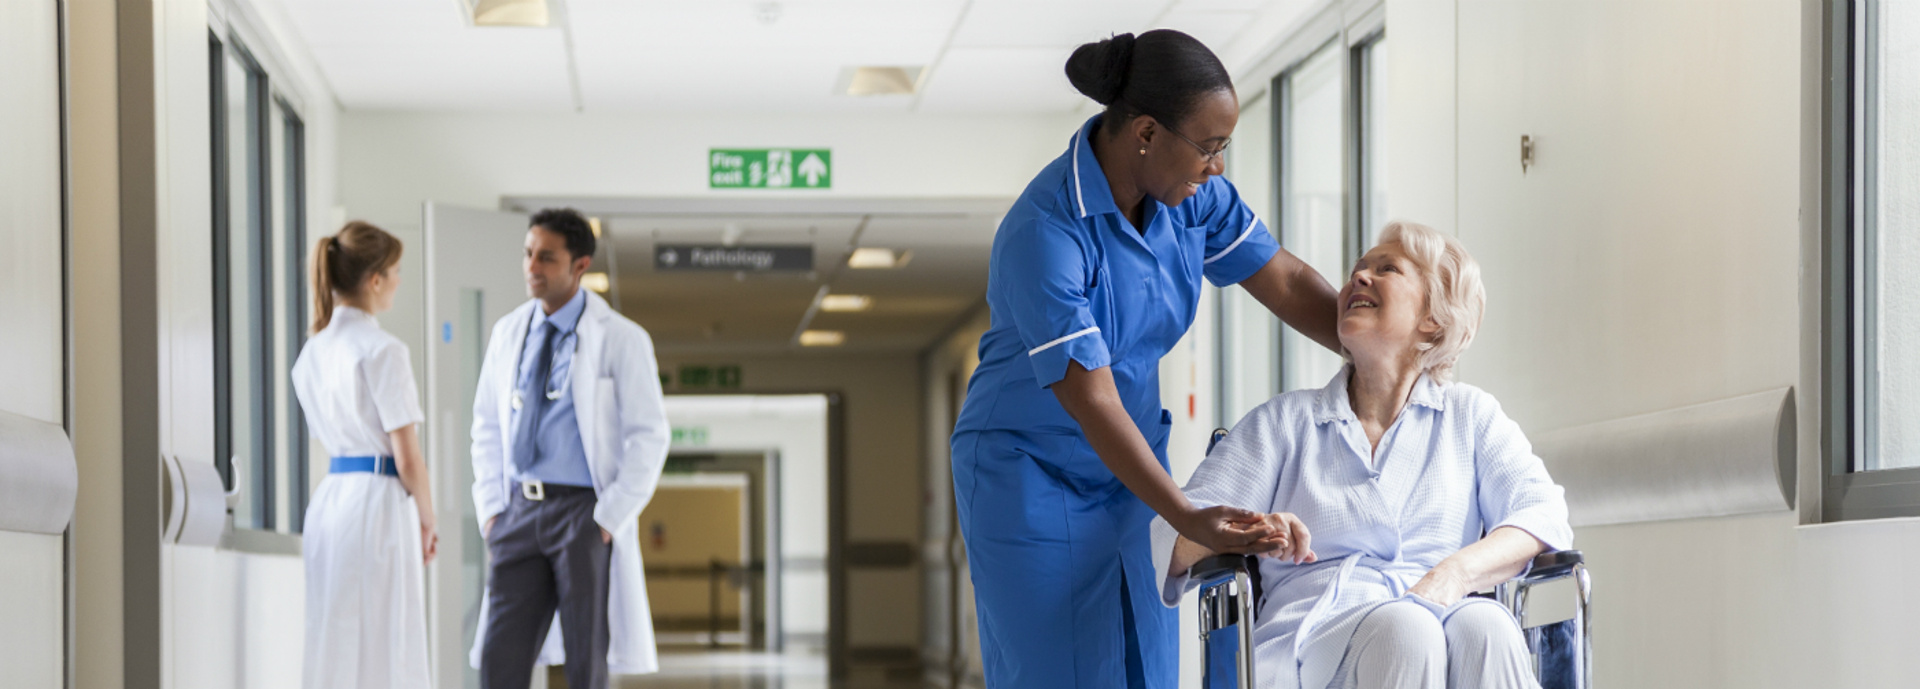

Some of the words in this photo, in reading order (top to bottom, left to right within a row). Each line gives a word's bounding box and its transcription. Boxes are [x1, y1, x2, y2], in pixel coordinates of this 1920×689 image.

[712, 152, 743, 169] Fire
[712, 170, 743, 185] exit
[691, 248, 774, 270] Pathology
